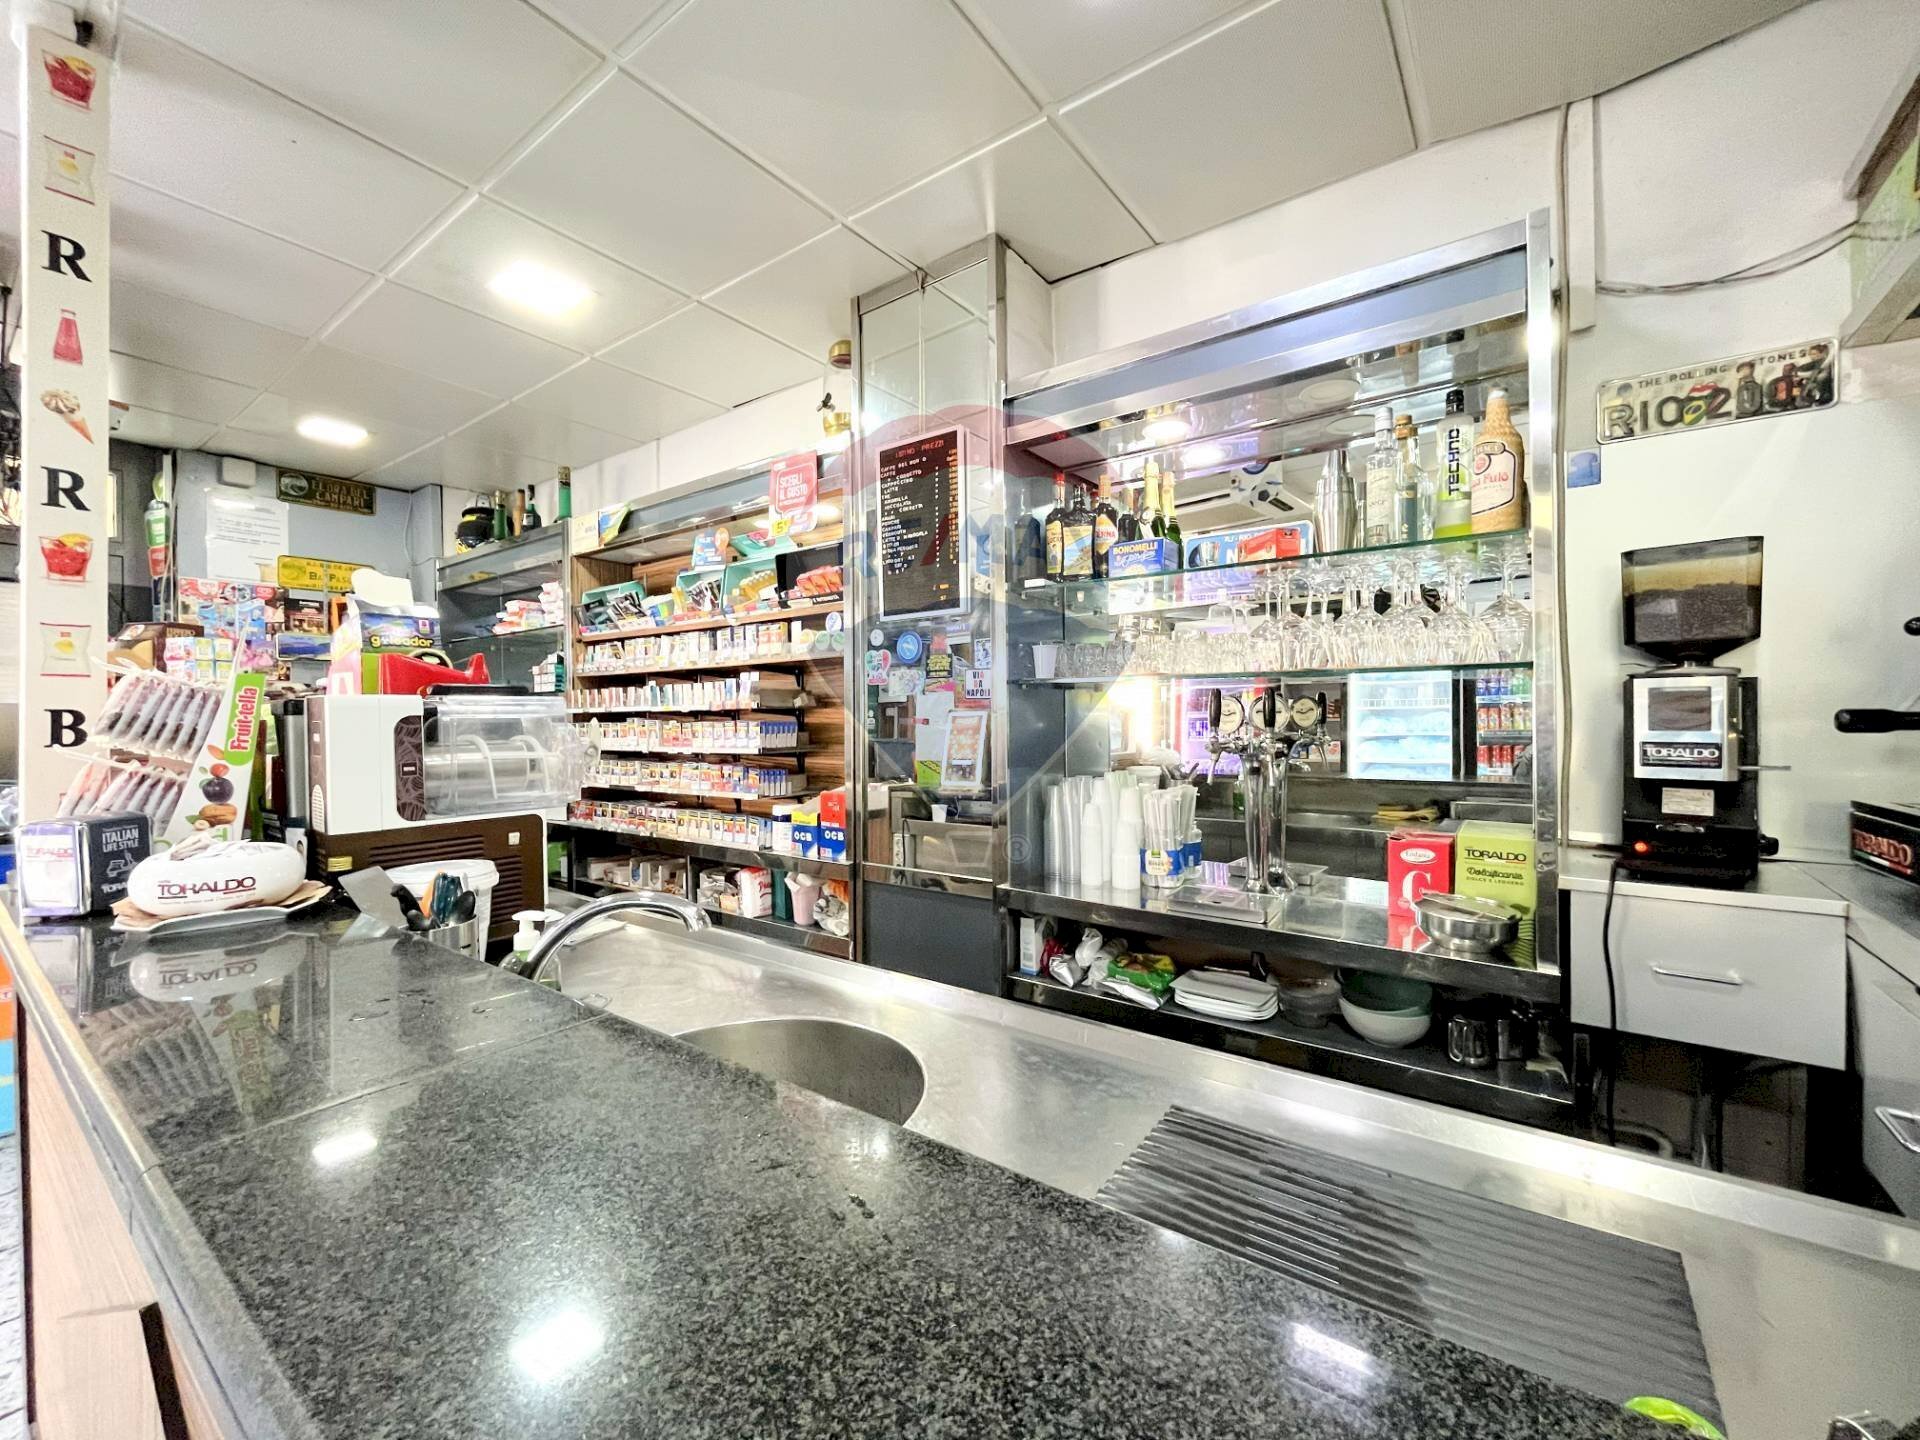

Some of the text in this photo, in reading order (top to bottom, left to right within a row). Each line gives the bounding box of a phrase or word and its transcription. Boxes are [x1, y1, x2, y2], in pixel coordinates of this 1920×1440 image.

[41, 229, 93, 283] R
[1637, 347, 1808, 389] THE ROLLING TONES
[1449, 428, 1460, 496] TECHNO
[40, 465, 92, 512] R
[967, 688, 991, 696] NAPOLI
[44, 708, 88, 748] B
[1643, 746, 1720, 758] TORALDO
[102, 828, 139, 845] ITALIAN
[794, 830, 813, 841] OCB
[824, 830, 844, 841] OCB
[103, 839, 139, 853] LIFE STYLE
[1464, 848, 1526, 862] TORALDO
[1852, 828, 1912, 866] TORALDO
[158, 877, 256, 896] TORALDO
